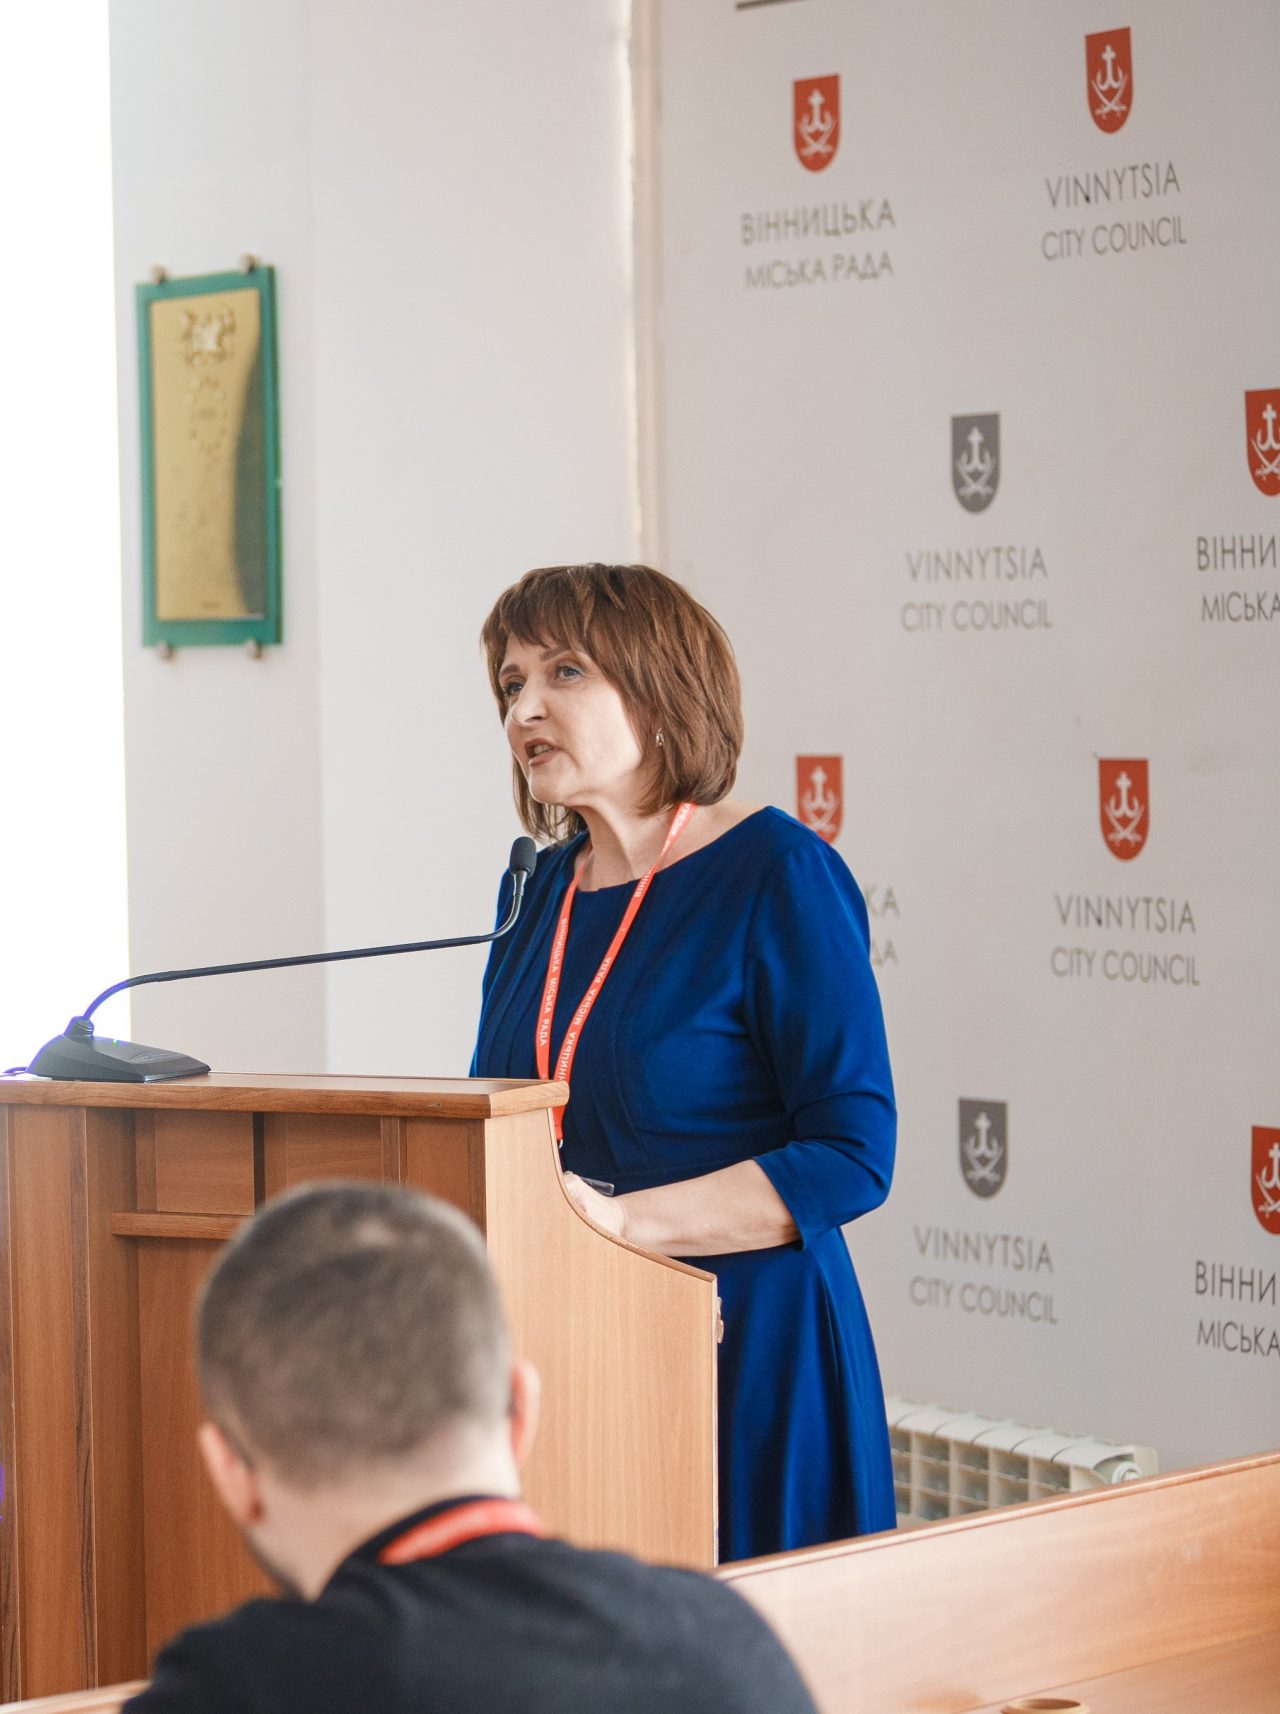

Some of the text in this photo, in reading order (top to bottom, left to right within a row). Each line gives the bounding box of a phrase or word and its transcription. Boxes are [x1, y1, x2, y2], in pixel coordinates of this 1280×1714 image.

[1044, 161, 1181, 208] VINNYTSIA
[741, 198, 896, 247] ВІННИЦЬКА
[1041, 215, 1188, 262] CITY COUNCIL
[745, 250, 894, 290] МІСЬКА РАДА
[905, 545, 1048, 581] VINNYTSIA
[1196, 533, 1277, 572] ВІННИ
[900, 599, 1053, 633] CITY COUNCIL
[1200, 590, 1280, 624] МІСЬКА
[1054, 893, 1197, 934] VINNYTSIA
[1050, 946, 1201, 987] CITY COUNCIL
[543, 977, 558, 1015] МІСЬКА
[538, 1018, 550, 1047] РАДА
[557, 956, 612, 1082] ННИЦЬКА МІСЬКА РАДА
[913, 1226, 1054, 1273] VINNYTSIA
[909, 1276, 1058, 1326] CITY COUNCIL
[1194, 1259, 1277, 1306] ВІННИ
[1196, 1319, 1280, 1357] МІСЬКА
